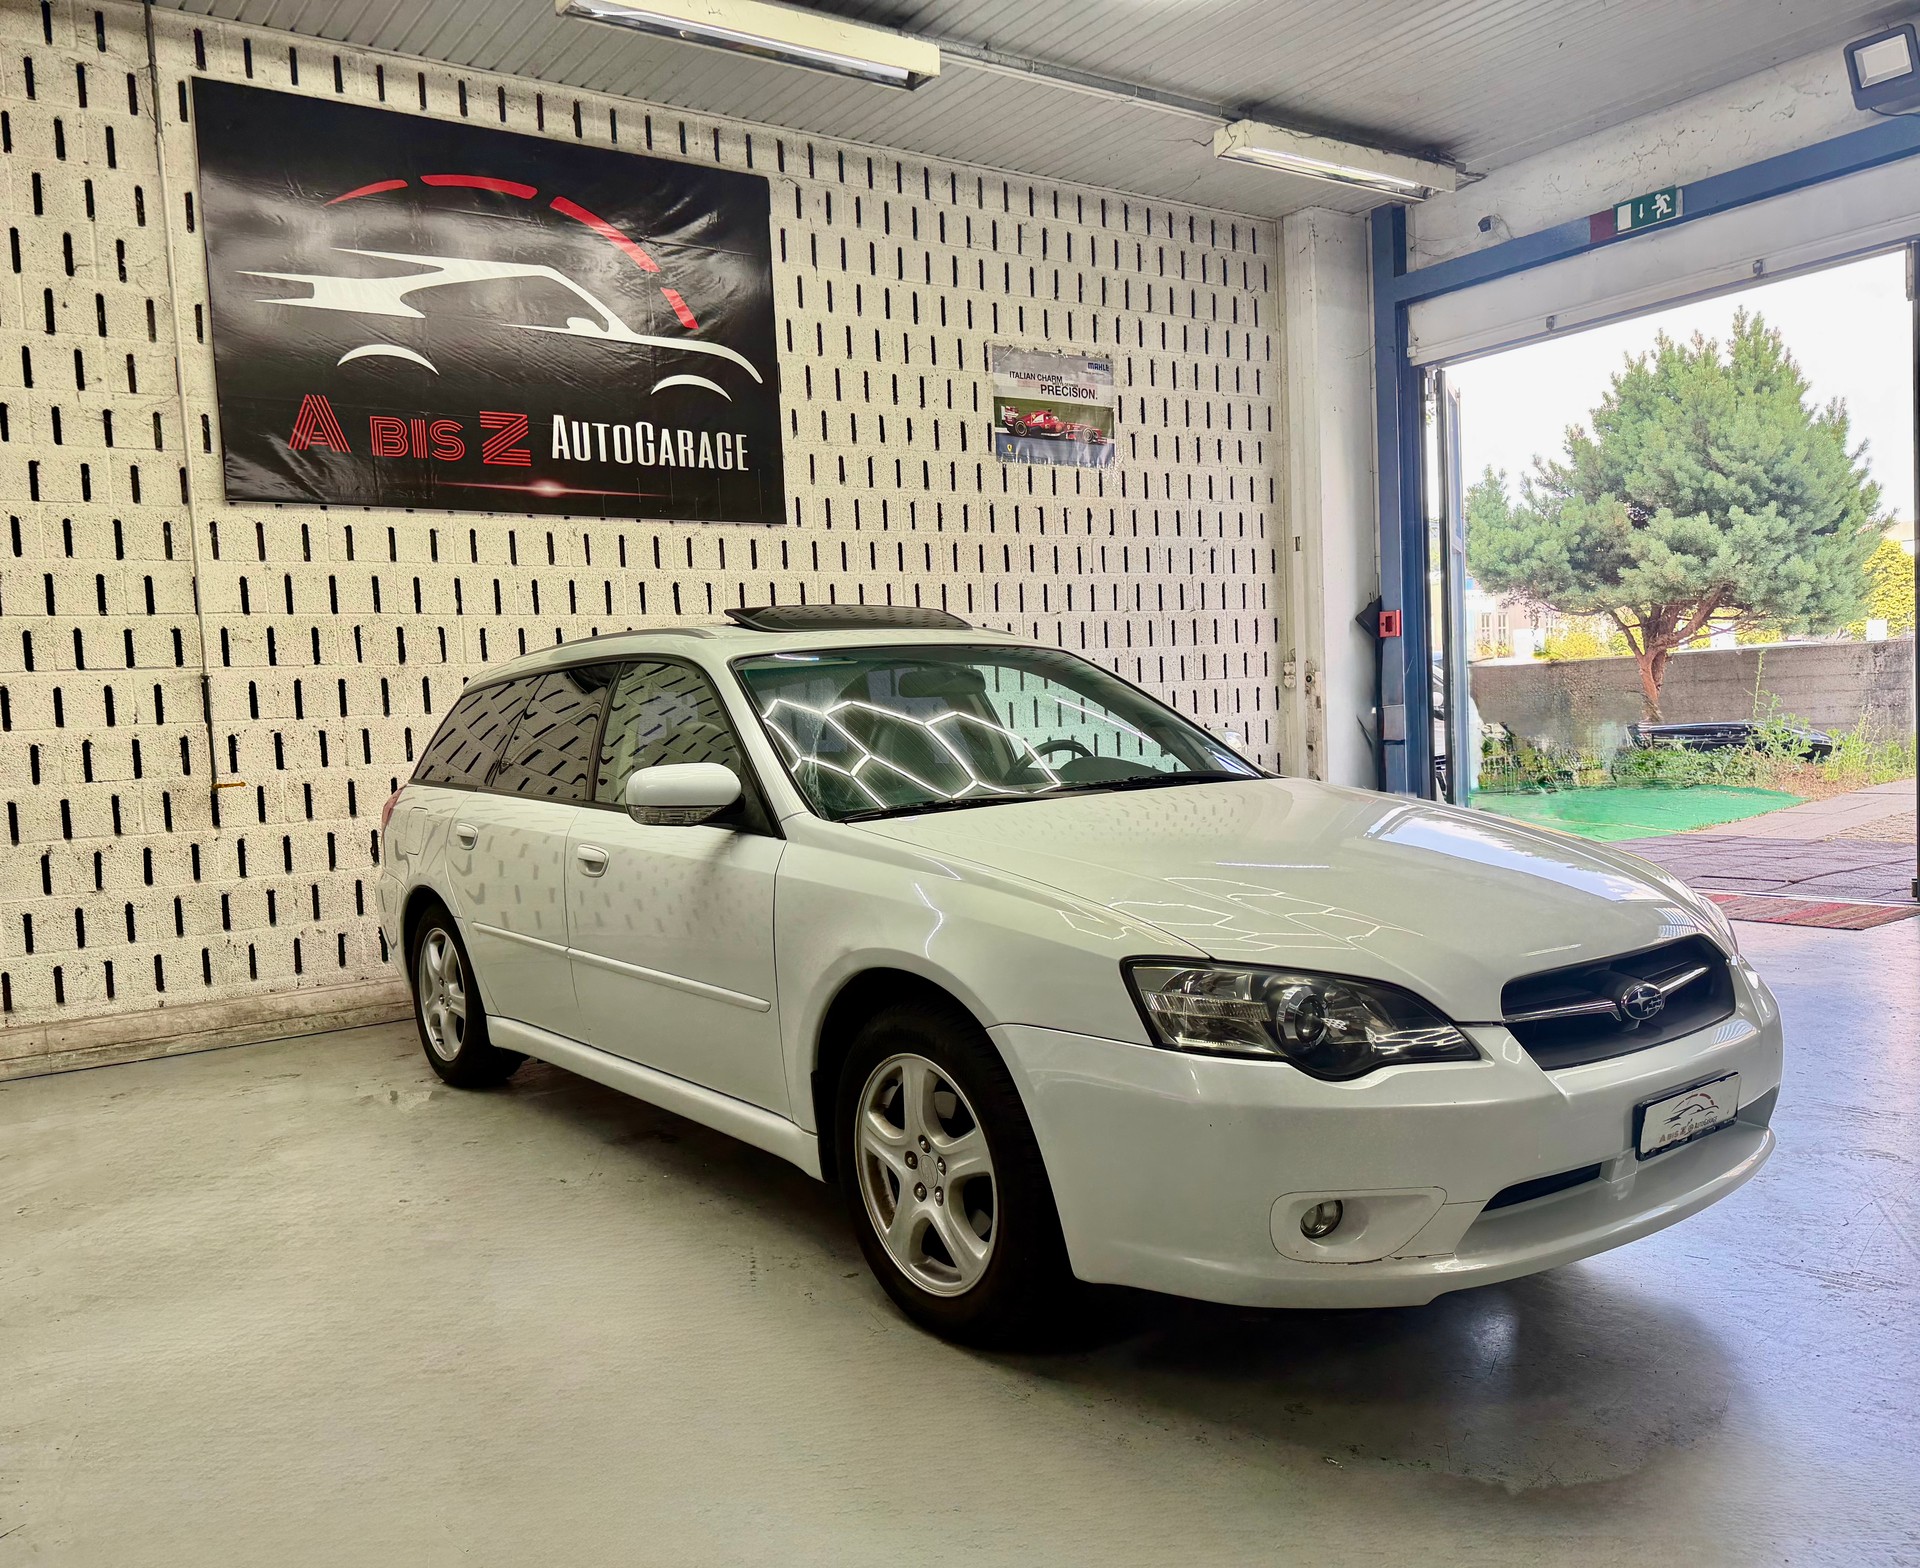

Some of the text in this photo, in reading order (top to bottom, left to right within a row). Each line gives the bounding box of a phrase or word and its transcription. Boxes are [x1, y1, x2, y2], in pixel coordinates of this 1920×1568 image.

[1087, 362, 1109, 371] MAHLE
[1009, 371, 1062, 383] ITALIAN CHARM
[1041, 384, 1098, 399] PRECISION.
[287, 394, 352, 453] A
[369, 415, 466, 461] BIS
[479, 411, 532, 467] Z
[1659, 1134, 1666, 1143] A
